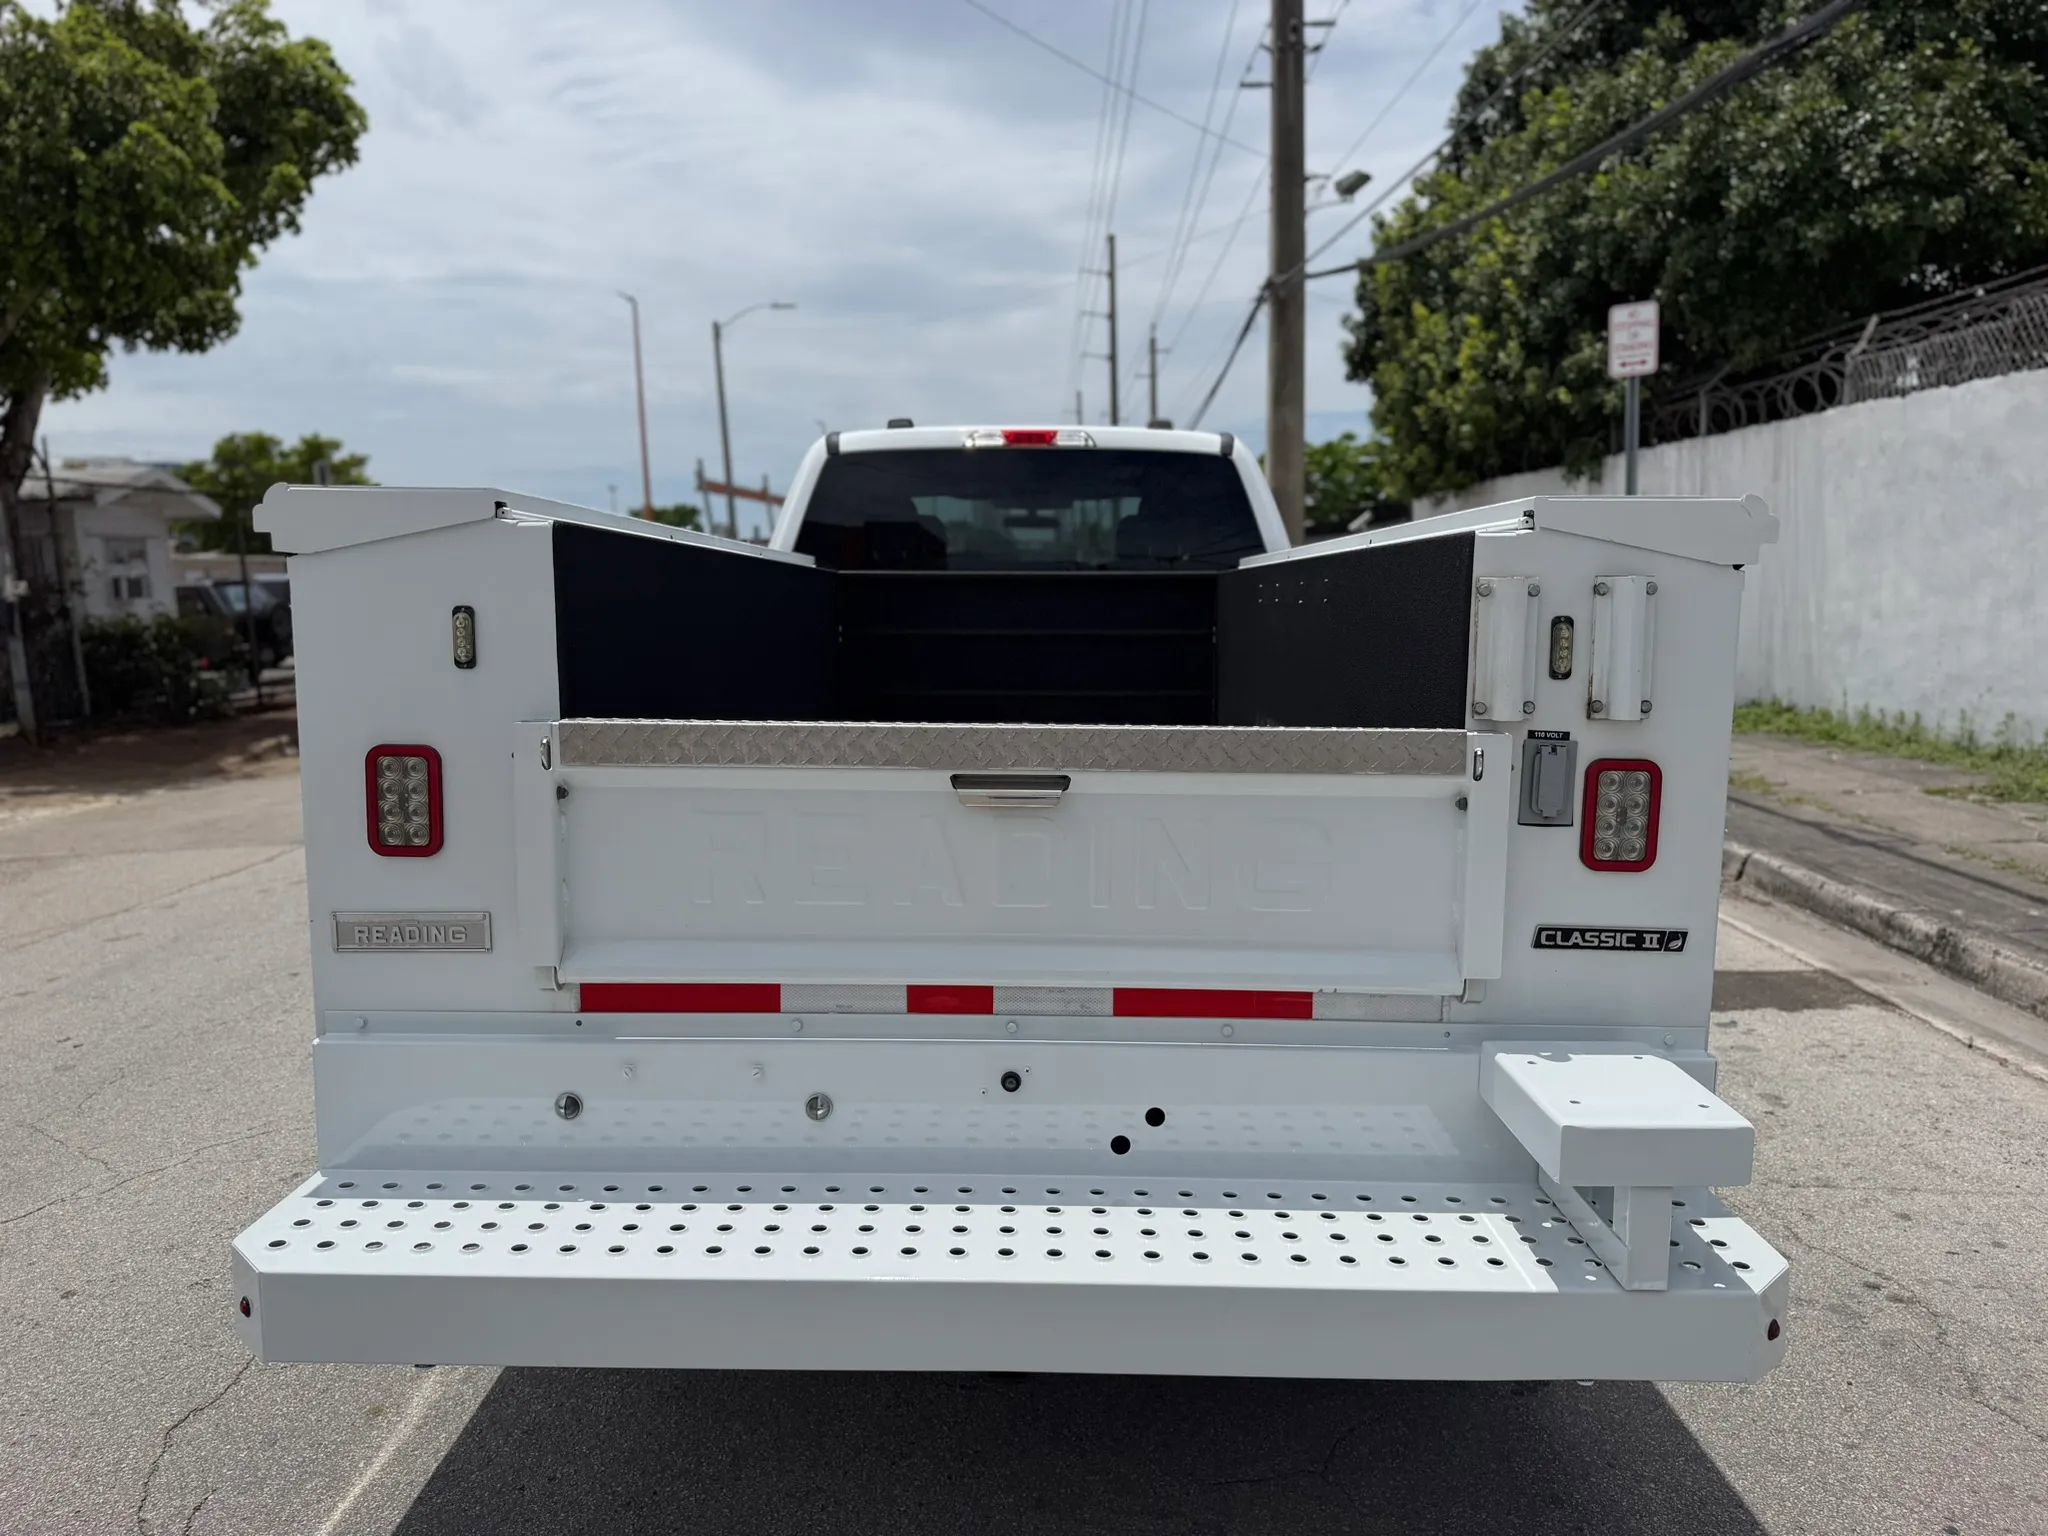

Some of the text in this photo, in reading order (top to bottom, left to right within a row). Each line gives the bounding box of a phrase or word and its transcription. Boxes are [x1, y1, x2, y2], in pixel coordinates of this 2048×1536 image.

[690, 808, 1333, 913] READING
[353, 926, 468, 945] READING
[1540, 930, 1661, 948] CLASSIC II
